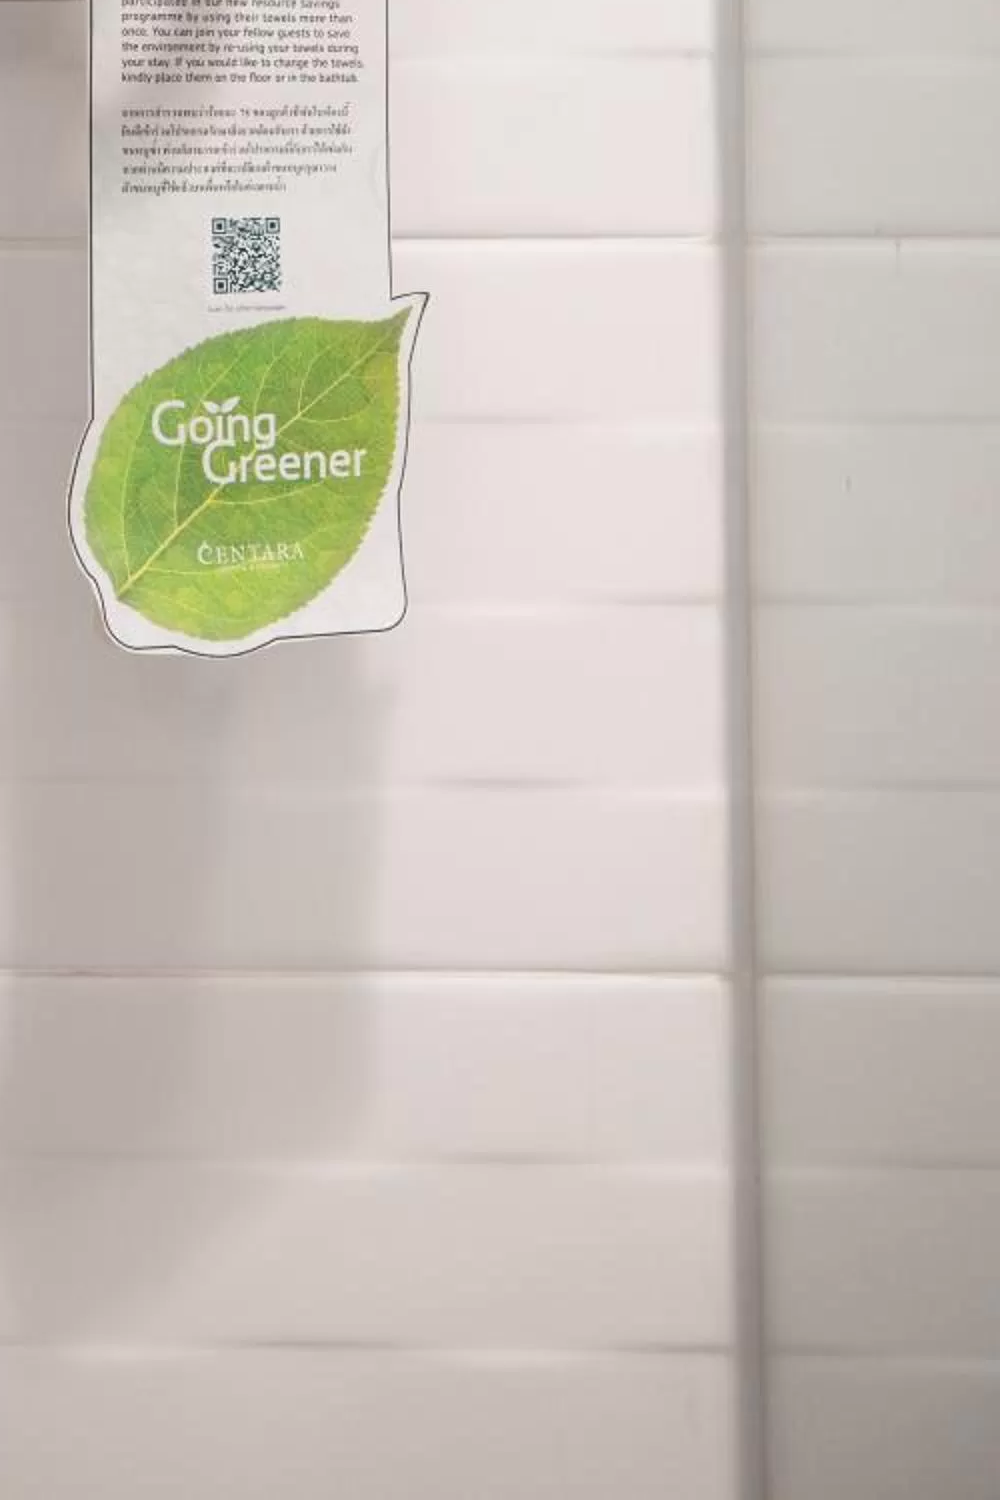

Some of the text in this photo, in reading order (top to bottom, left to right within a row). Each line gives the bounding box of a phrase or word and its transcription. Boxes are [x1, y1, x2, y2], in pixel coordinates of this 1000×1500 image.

[252, 0, 296, 8] resource
[301, 0, 340, 9] savings
[122, 13, 183, 23] programme
[186, 13, 198, 23] by
[202, 13, 231, 24] using
[235, 13, 258, 22] their
[263, 13, 296, 22] towels
[329, 14, 353, 22] than
[153, 26, 171, 36] You
[174, 28, 192, 36] can
[195, 28, 214, 38] join
[218, 29, 240, 37] your
[244, 28, 274, 36] fellow
[278, 29, 310, 39] guests
[327, 30, 350, 38] save
[122, 42, 138, 52] the
[141, 43, 205, 52] environment
[208, 43, 220, 53] by
[268, 45, 289, 53] your
[293, 44, 324, 53] towels
[328, 44, 358, 54] during
[122, 59, 145, 68] your
[175, 57, 182, 66] If
[186, 59, 204, 68] you
[207, 57, 238, 66] would
[240, 58, 258, 67] like
[261, 59, 270, 67] to
[274, 59, 308, 69] change
[312, 59, 328, 67] the
[122, 72, 152, 83] kindly
[155, 72, 182, 83] place
[186, 73, 212, 82] them
[230, 73, 246, 82] the
[250, 72, 271, 82] floor
[288, 74, 296, 82] in
[300, 74, 316, 82] the
[152, 398, 278, 450] Going
[202, 443, 367, 485] Greener
[196, 540, 304, 565] CENTARA
